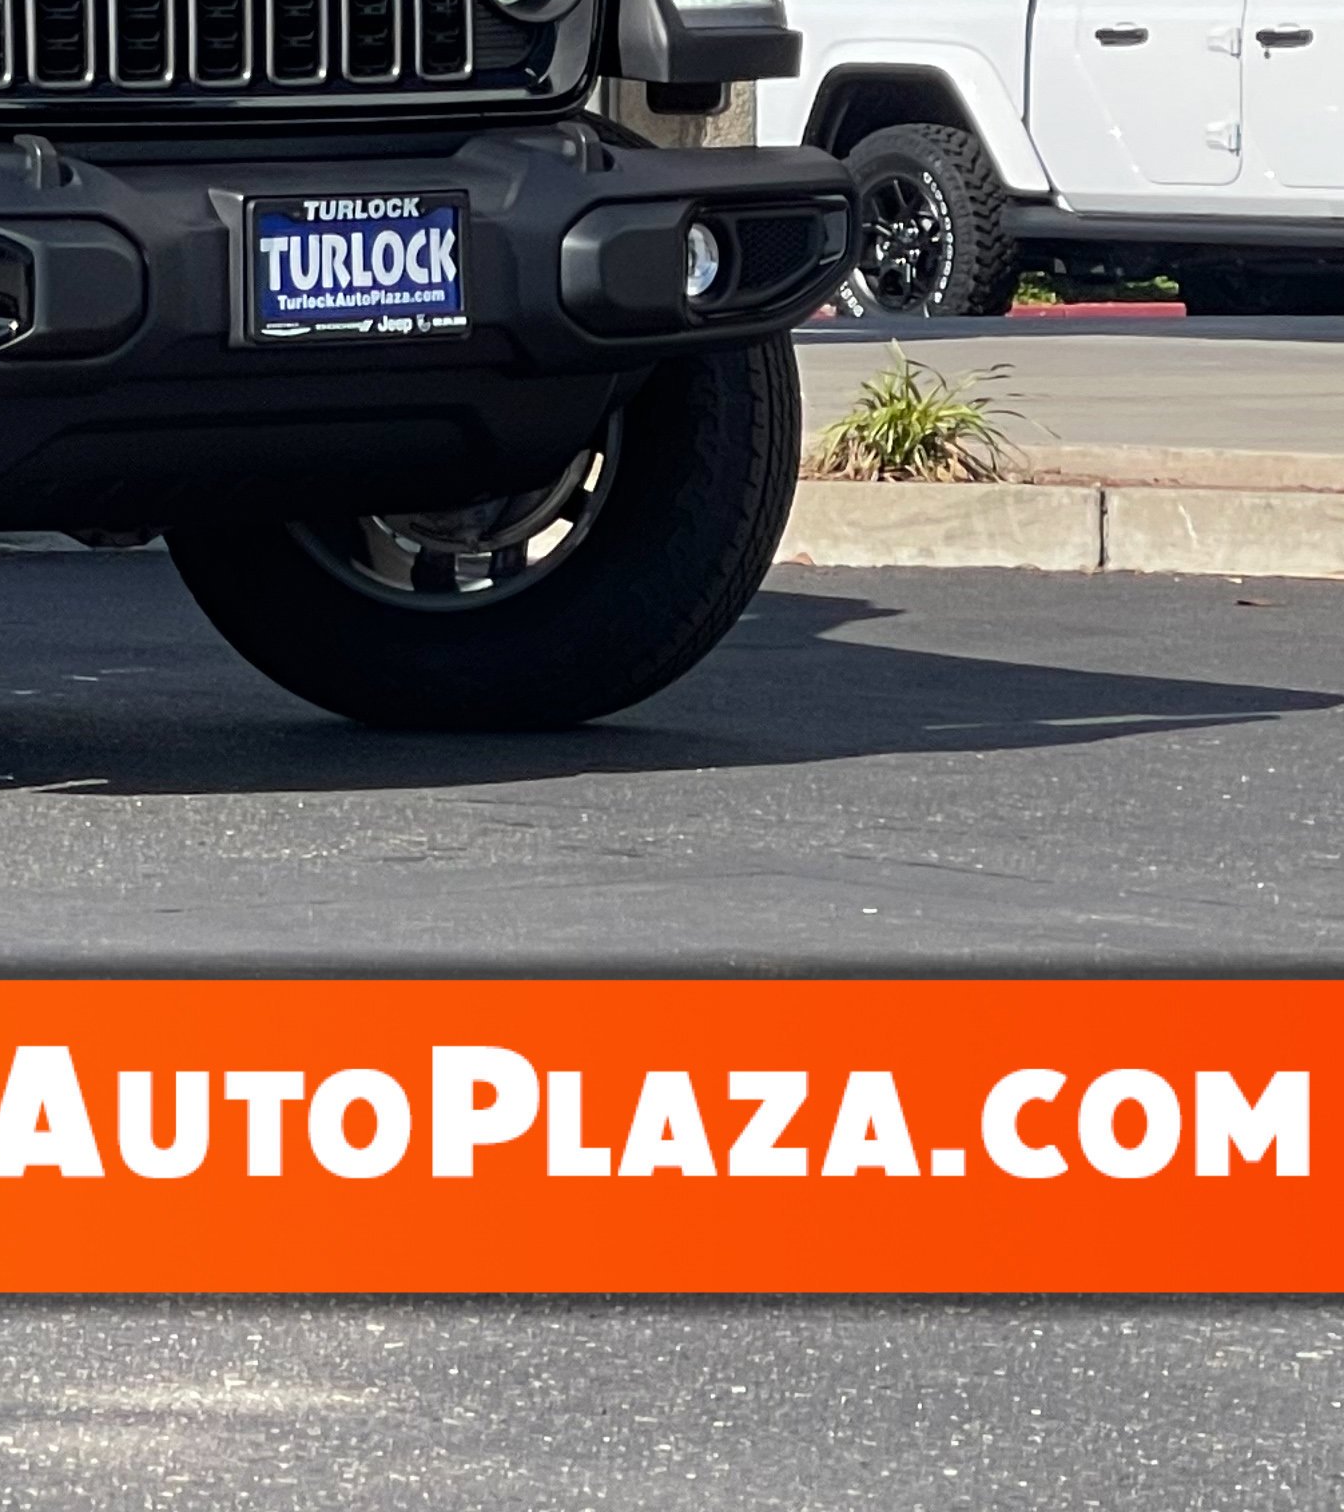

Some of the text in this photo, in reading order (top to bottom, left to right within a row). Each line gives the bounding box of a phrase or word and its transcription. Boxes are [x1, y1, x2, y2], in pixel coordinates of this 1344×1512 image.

[303, 197, 421, 221] TURLOCK
[260, 228, 457, 291] TURLOCK
[277, 289, 445, 311] TurlockAutoPlaza.com
[378, 314, 413, 334] Jeep
